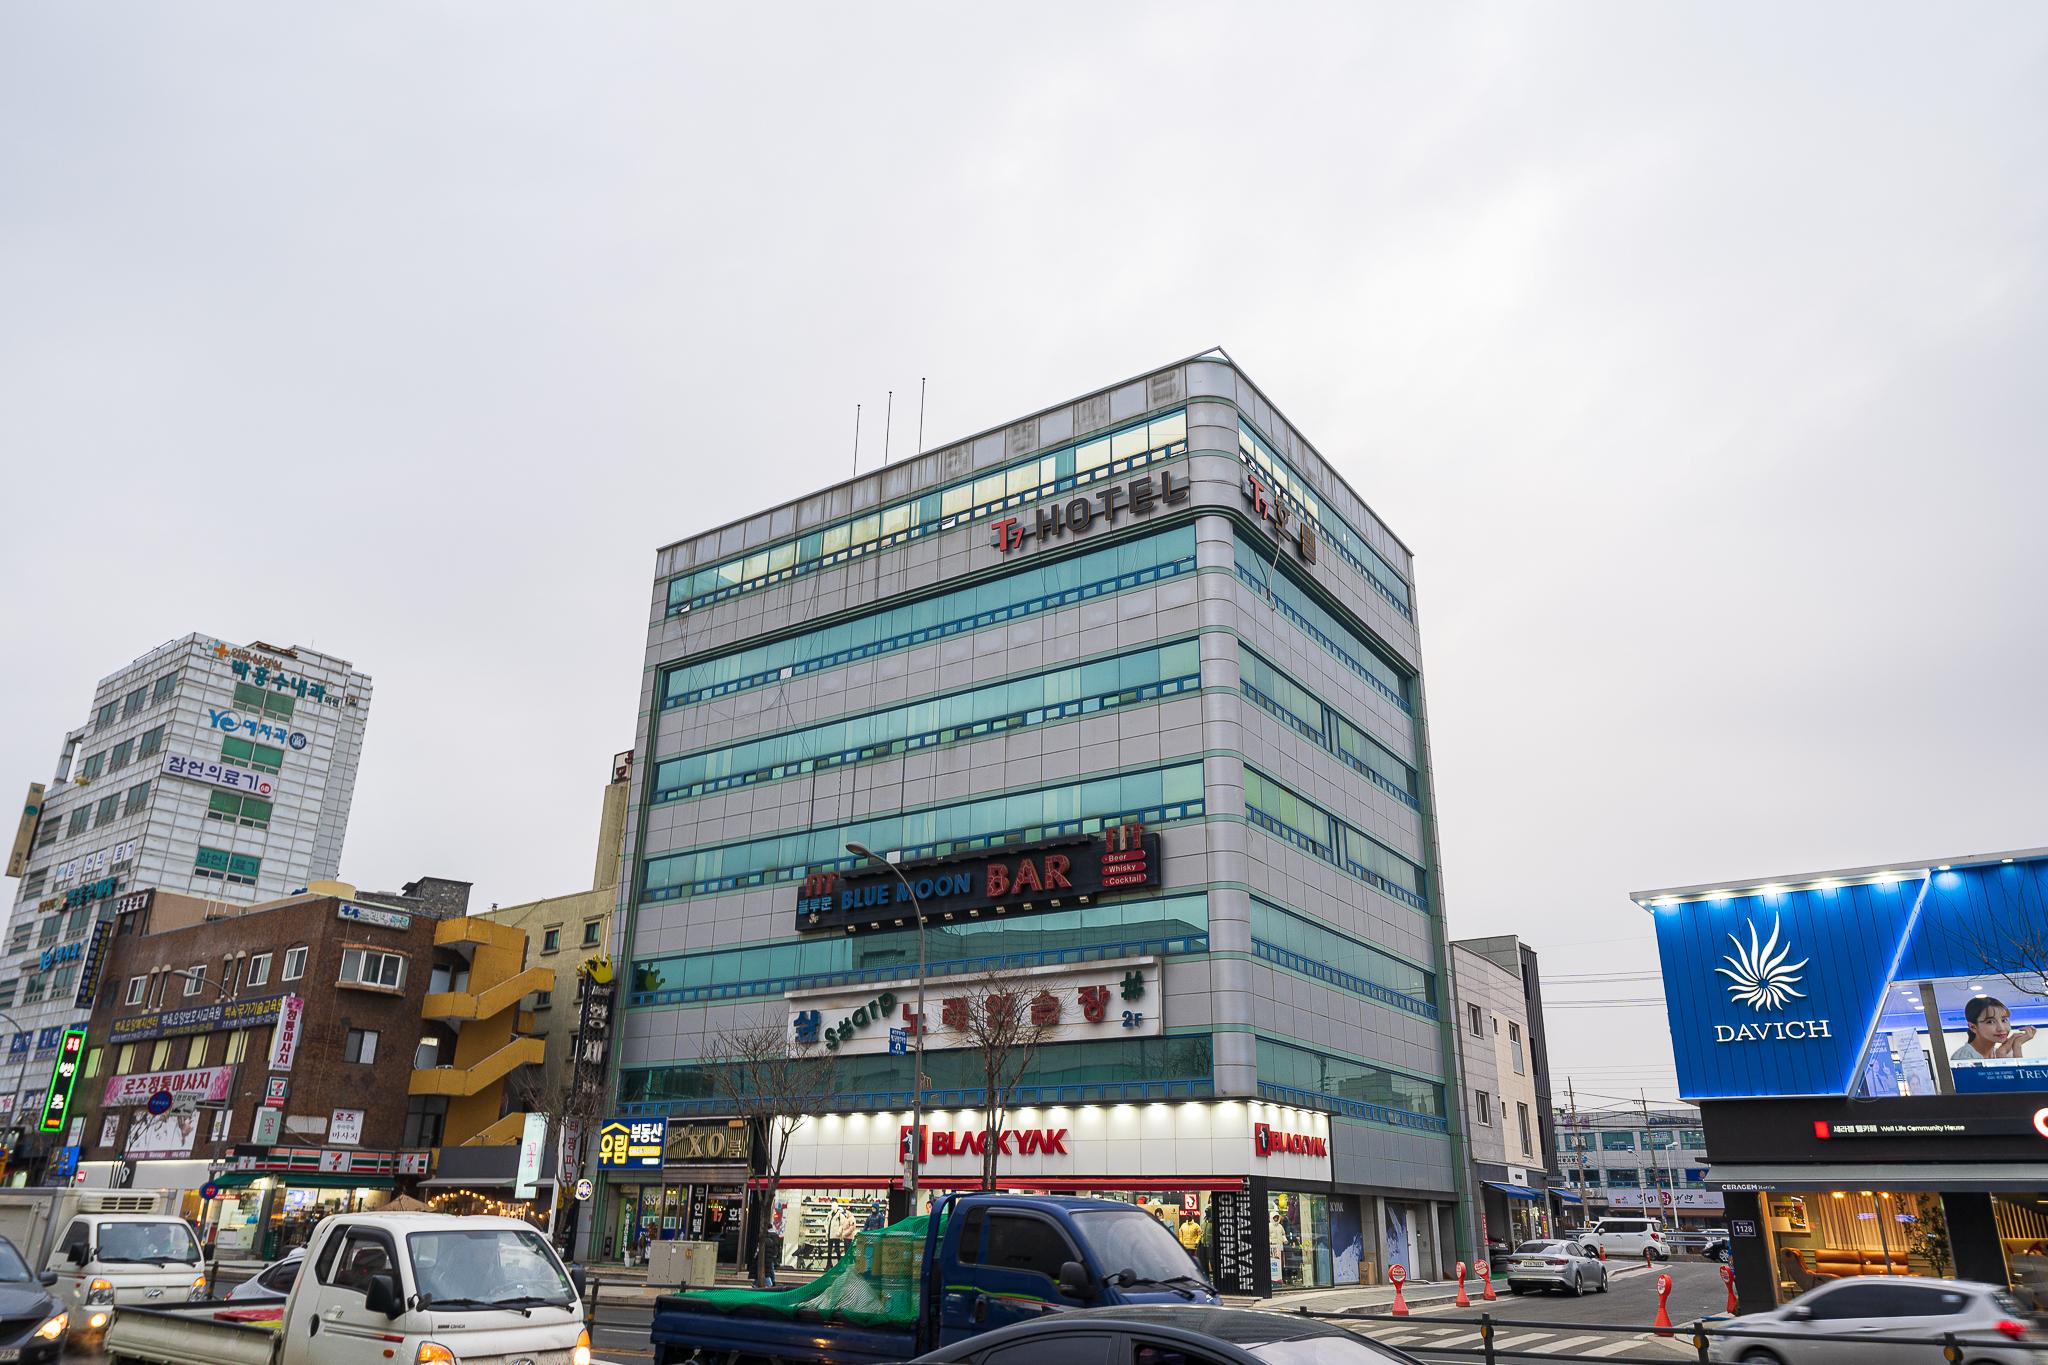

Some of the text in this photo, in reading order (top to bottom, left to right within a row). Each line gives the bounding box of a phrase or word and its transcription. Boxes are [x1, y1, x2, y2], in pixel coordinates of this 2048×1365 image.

[1036, 471, 1188, 540] HOTEL
[169, 756, 260, 792] 잠언의료기
[1108, 854, 1126, 862] Beer
[1109, 864, 1136, 873] Whisky
[841, 855, 1072, 912] BLUE MOON BAR
[1109, 874, 1142, 885] Cocktail
[1122, 1010, 1143, 1028] 2F
[1714, 1019, 1832, 1043] DAVICH
[123, 1071, 211, 1095] 로즈정통마사지
[631, 1123, 662, 1143] 부동산
[686, 1132, 725, 1158] XO
[932, 1129, 1068, 1156] BLACKYAK
[1270, 1130, 1328, 1157] BLACKYAK
[599, 1133, 628, 1165] 우림
[1219, 1194, 1236, 1279] ORIGINAL
[1735, 1224, 1753, 1233] 1128
